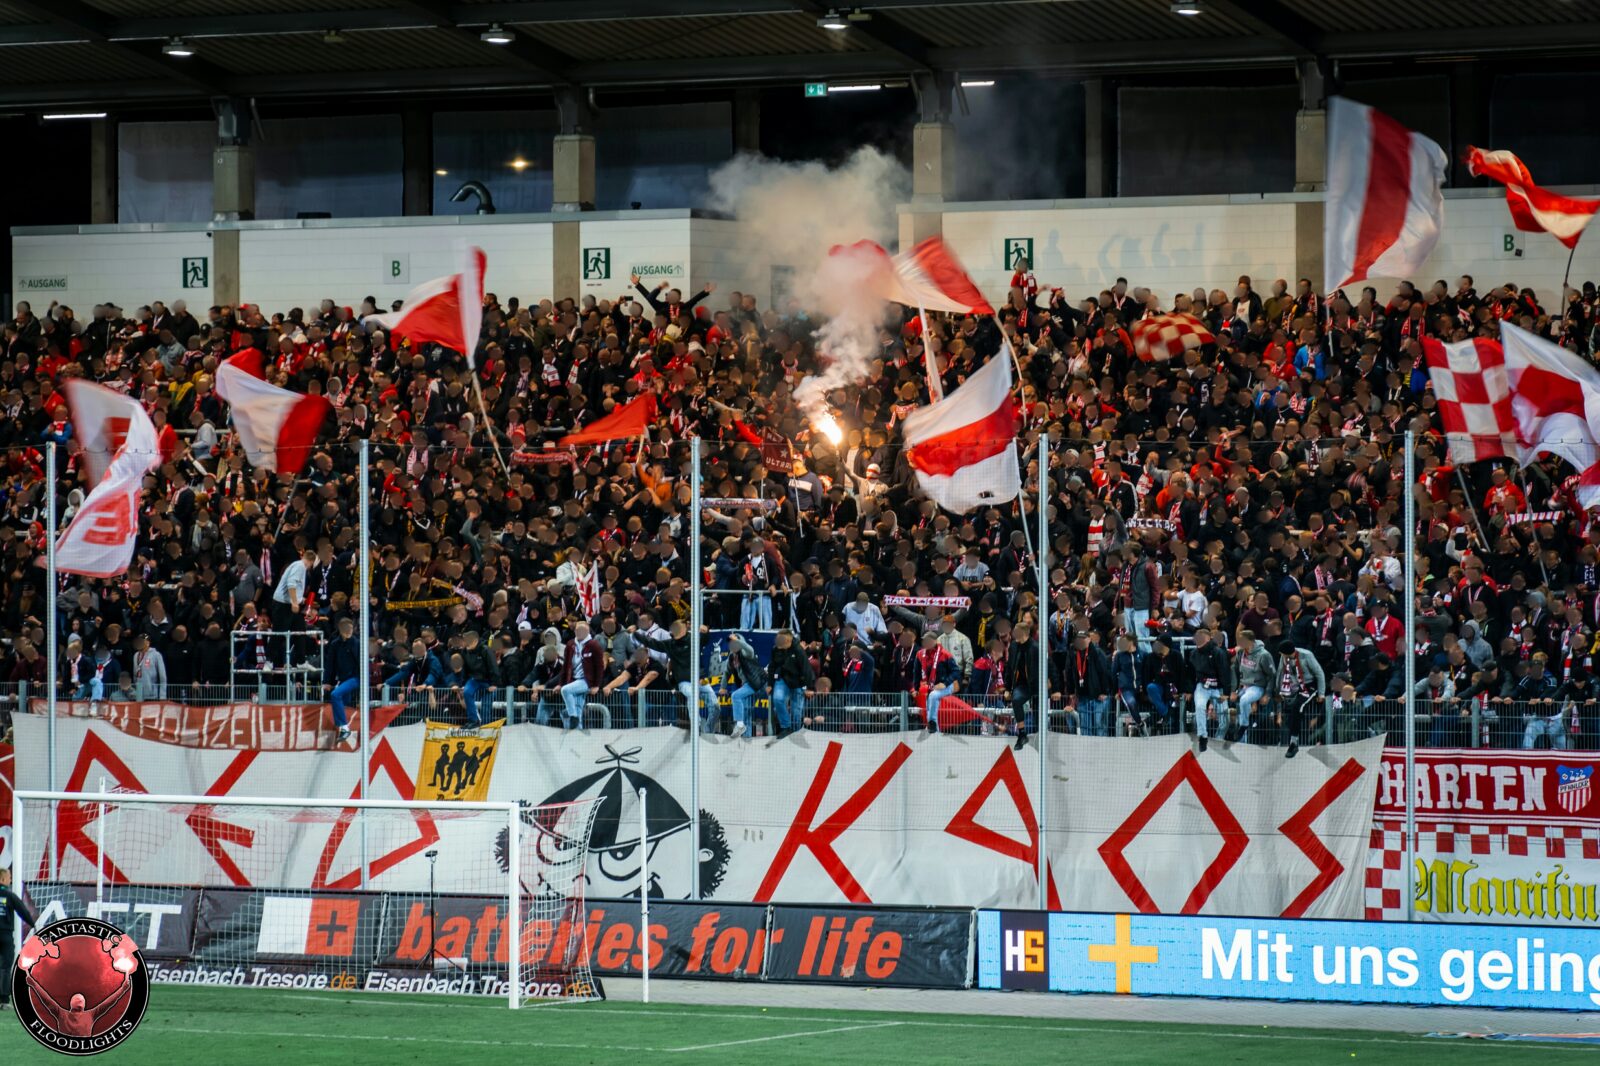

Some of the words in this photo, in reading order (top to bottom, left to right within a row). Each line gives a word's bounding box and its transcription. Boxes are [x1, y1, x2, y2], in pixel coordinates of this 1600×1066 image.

[1504, 235, 1515, 251] B
[28, 278, 66, 289] AUSGANG
[391, 260, 401, 278] B
[632, 265, 673, 275] AUSGANG
[752, 741, 1366, 918] KAOS
[1415, 858, 1600, 922] Mauritiu
[396, 903, 668, 970] batteries
[686, 912, 784, 975] for
[797, 916, 902, 979] life
[1005, 930, 1044, 972] HS
[1201, 928, 1293, 983] Mit
[1314, 945, 1419, 988] uns
[364, 972, 475, 994] Eisenbach
